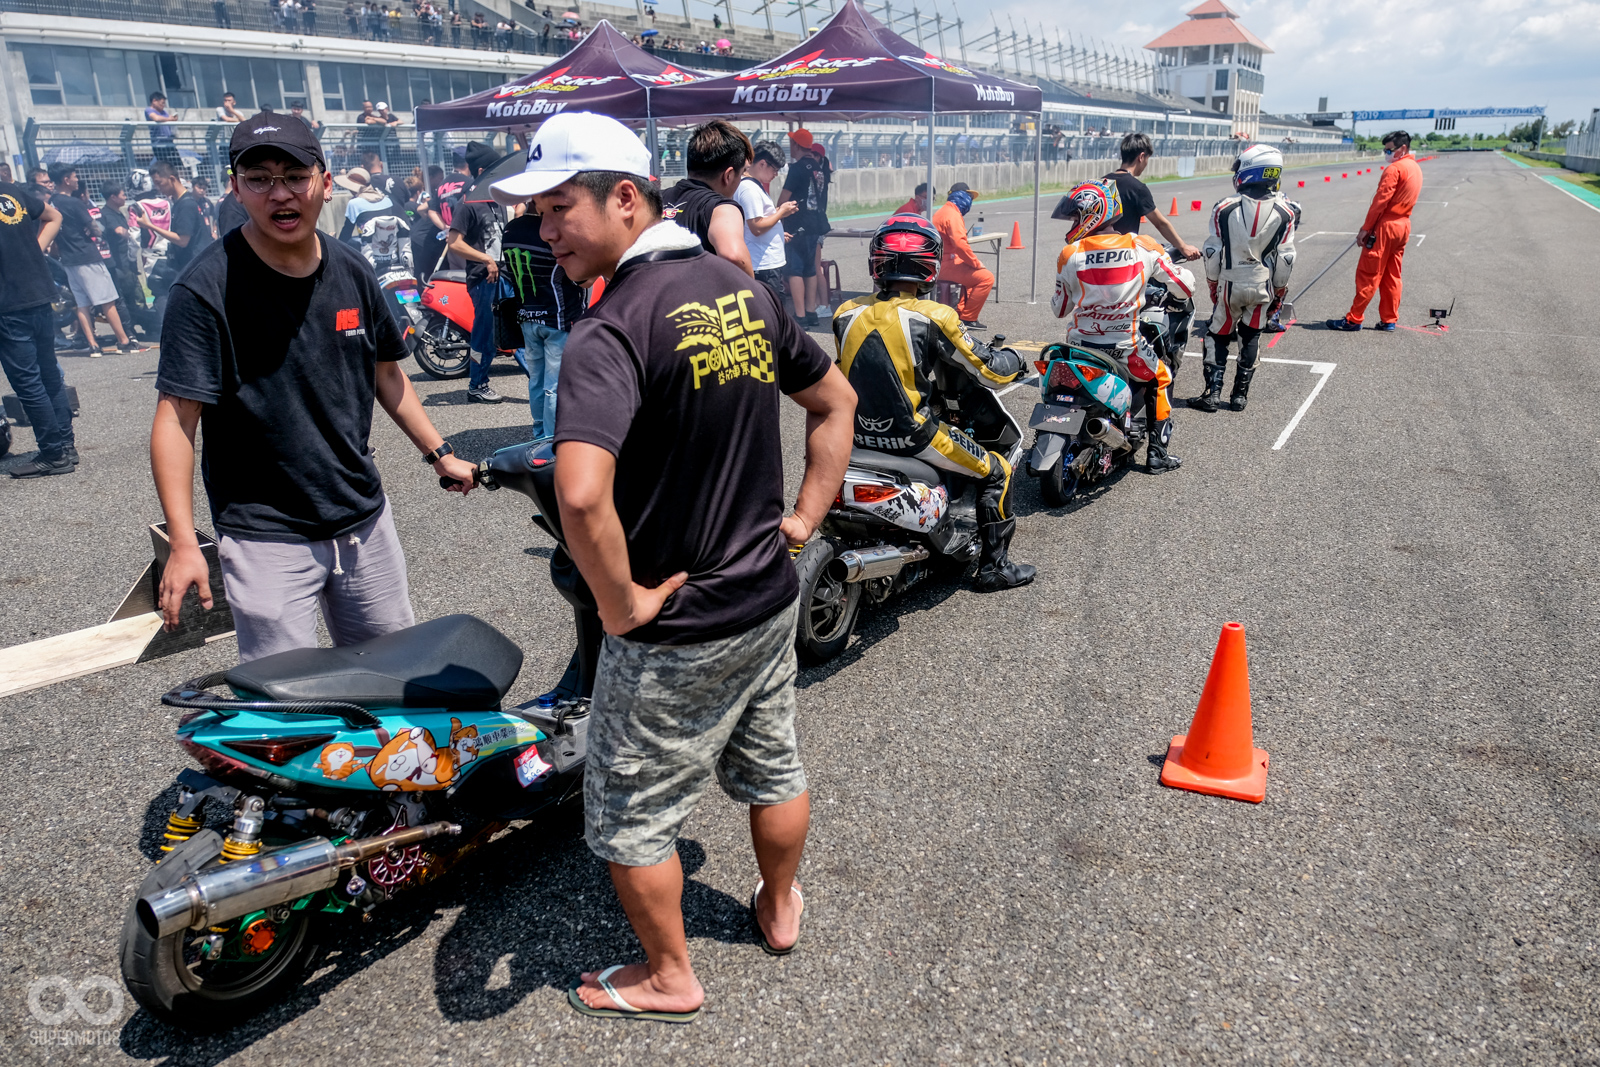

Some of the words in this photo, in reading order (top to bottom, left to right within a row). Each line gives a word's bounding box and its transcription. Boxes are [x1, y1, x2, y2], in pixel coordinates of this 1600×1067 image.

[731, 83, 834, 105] MotoBuy
[973, 84, 1014, 106] MotoBuy
[486, 99, 568, 118] MotoBuy
[1356, 111, 1379, 119] 2019
[1085, 250, 1133, 265] REPSOL
[715, 289, 766, 340] EC
[1105, 323, 1131, 331] ride
